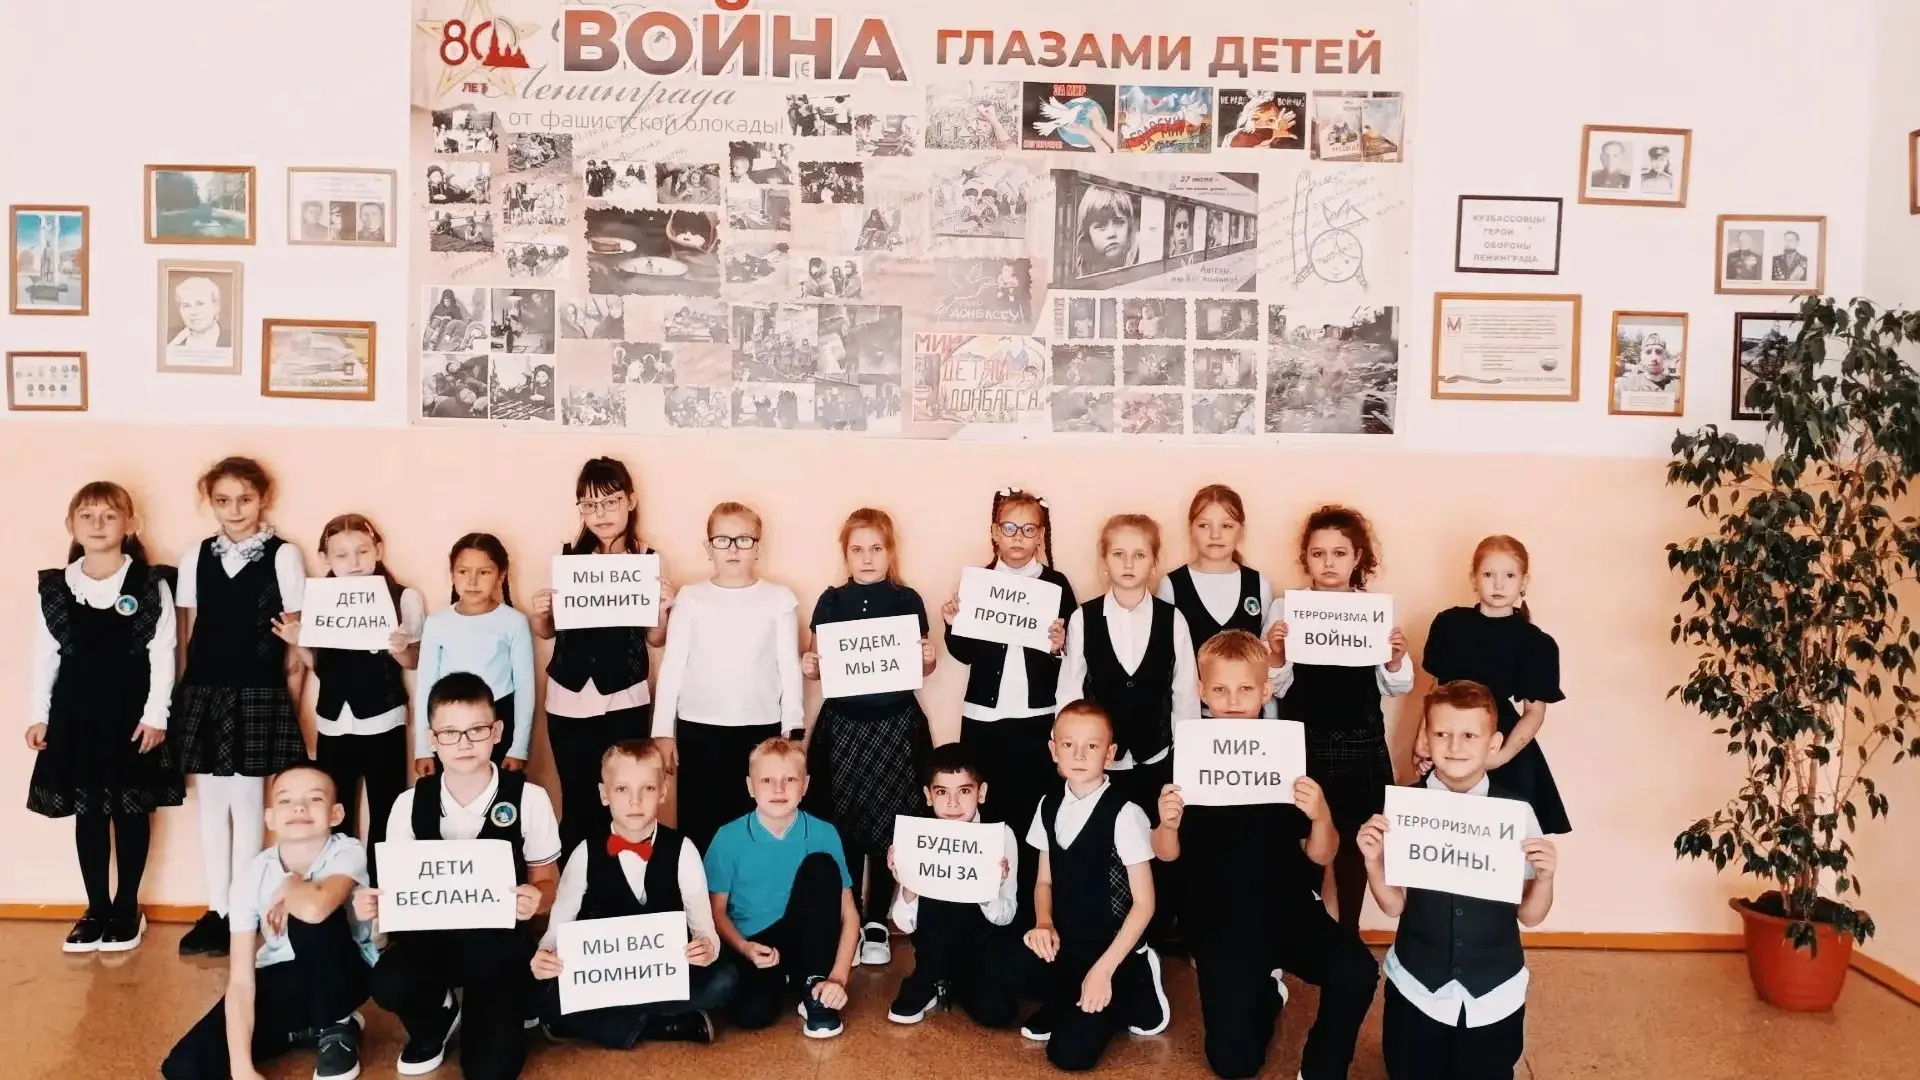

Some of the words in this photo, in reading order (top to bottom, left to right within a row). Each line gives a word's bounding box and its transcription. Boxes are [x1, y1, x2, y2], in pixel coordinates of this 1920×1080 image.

[564, 0, 908, 81] ВОЙНА
[936, 29, 1192, 71] ГЛАЗАМИ
[1208, 29, 1382, 77] ДЕТЕЙ
[462, 82, 489, 93] ЛЕТ
[497, 62, 737, 134] Ленинграда
[508, 112, 531, 126] от
[540, 109, 677, 134] фашистской
[1472, 214, 1546, 224] КУЗБАССОВЦЫ
[1483, 228, 1515, 236] ГЕРОИ
[1484, 241, 1532, 250] ОБОРОНЫ
[1472, 254, 1538, 263] ЛЕНИНГРАДА
[573, 570, 604, 583] МЫ
[610, 569, 642, 583] ВАС
[336, 591, 375, 608] ДЕТИ
[564, 593, 650, 608] ПОМНИТЬ
[989, 585, 1030, 605] МИР.
[315, 615, 390, 629] БЕСЛАНА.
[974, 607, 1038, 630] ПРОТИВ
[1292, 610, 1368, 623] ТЕРРОРИЗМА
[1373, 610, 1384, 623] И
[838, 633, 901, 652] БУДЕМ.
[1304, 628, 1373, 649] ВОЙНЫ.
[845, 660, 875, 676] МЫ
[880, 658, 900, 673] ЗА
[1213, 739, 1266, 756] МИР.
[1199, 769, 1282, 786] ПРОТИВ
[1396, 814, 1492, 838] ТЕРРОРИЗМА
[1499, 822, 1515, 841] И
[917, 834, 983, 855] БУДЕМ.
[1408, 842, 1496, 873] ВОЙНЫ.
[418, 859, 473, 880] ДЕТИ
[919, 862, 951, 879] МЫ
[956, 865, 978, 881] ЗА
[396, 888, 501, 906] БЕСЛАНА.
[582, 937, 620, 955] МЫ
[627, 933, 665, 952] ВАС
[573, 962, 677, 985] ПОМНИТЬ
